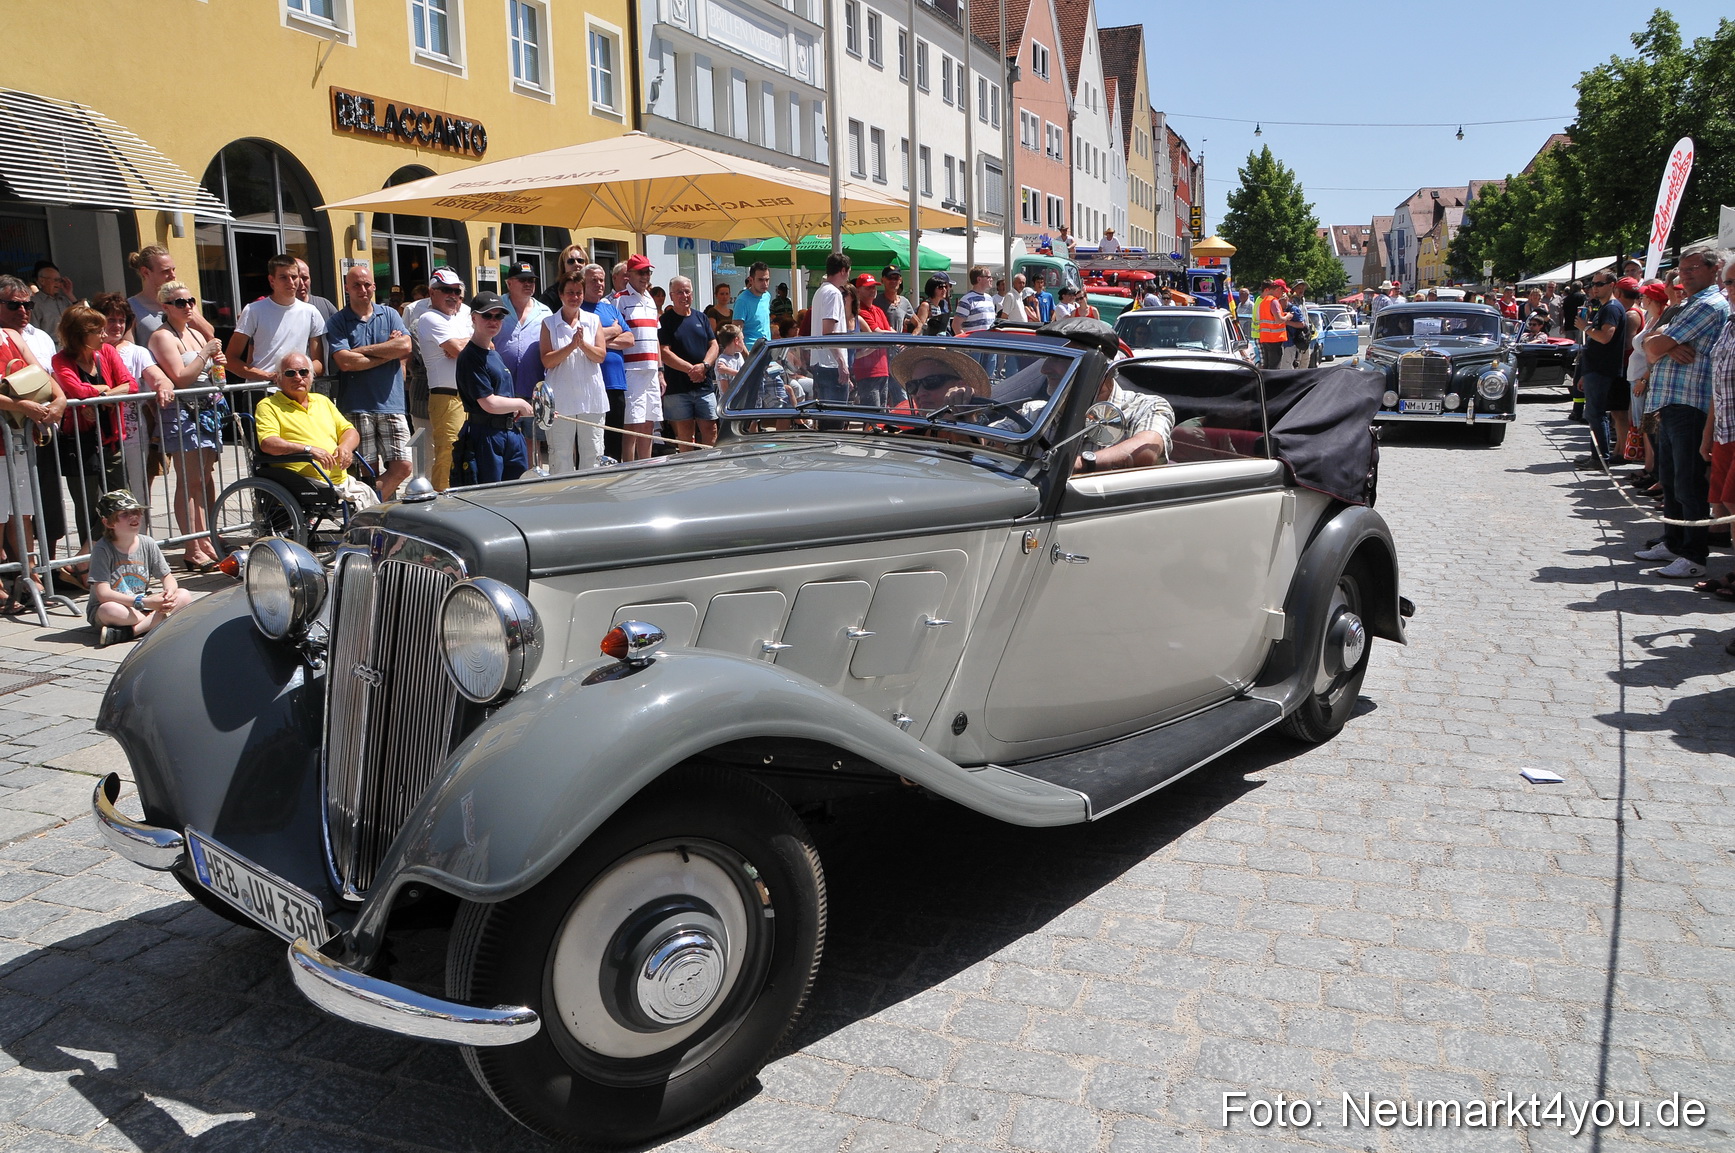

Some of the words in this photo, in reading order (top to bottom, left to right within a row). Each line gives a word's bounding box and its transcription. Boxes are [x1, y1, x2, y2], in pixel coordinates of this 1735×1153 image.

[709, 6, 750, 43] BRILLEN
[750, 26, 781, 55] WEBER
[336, 91, 487, 153] BELACCANTO
[448, 168, 620, 190] BELACCANTO
[1651, 150, 1683, 252] Lehmeier's
[1404, 402, 1416, 411] NM
[1421, 402, 1427, 410] V
[202, 847, 239, 899] HEB
[247, 875, 278, 924] UW
[277, 892, 323, 947] 33H
